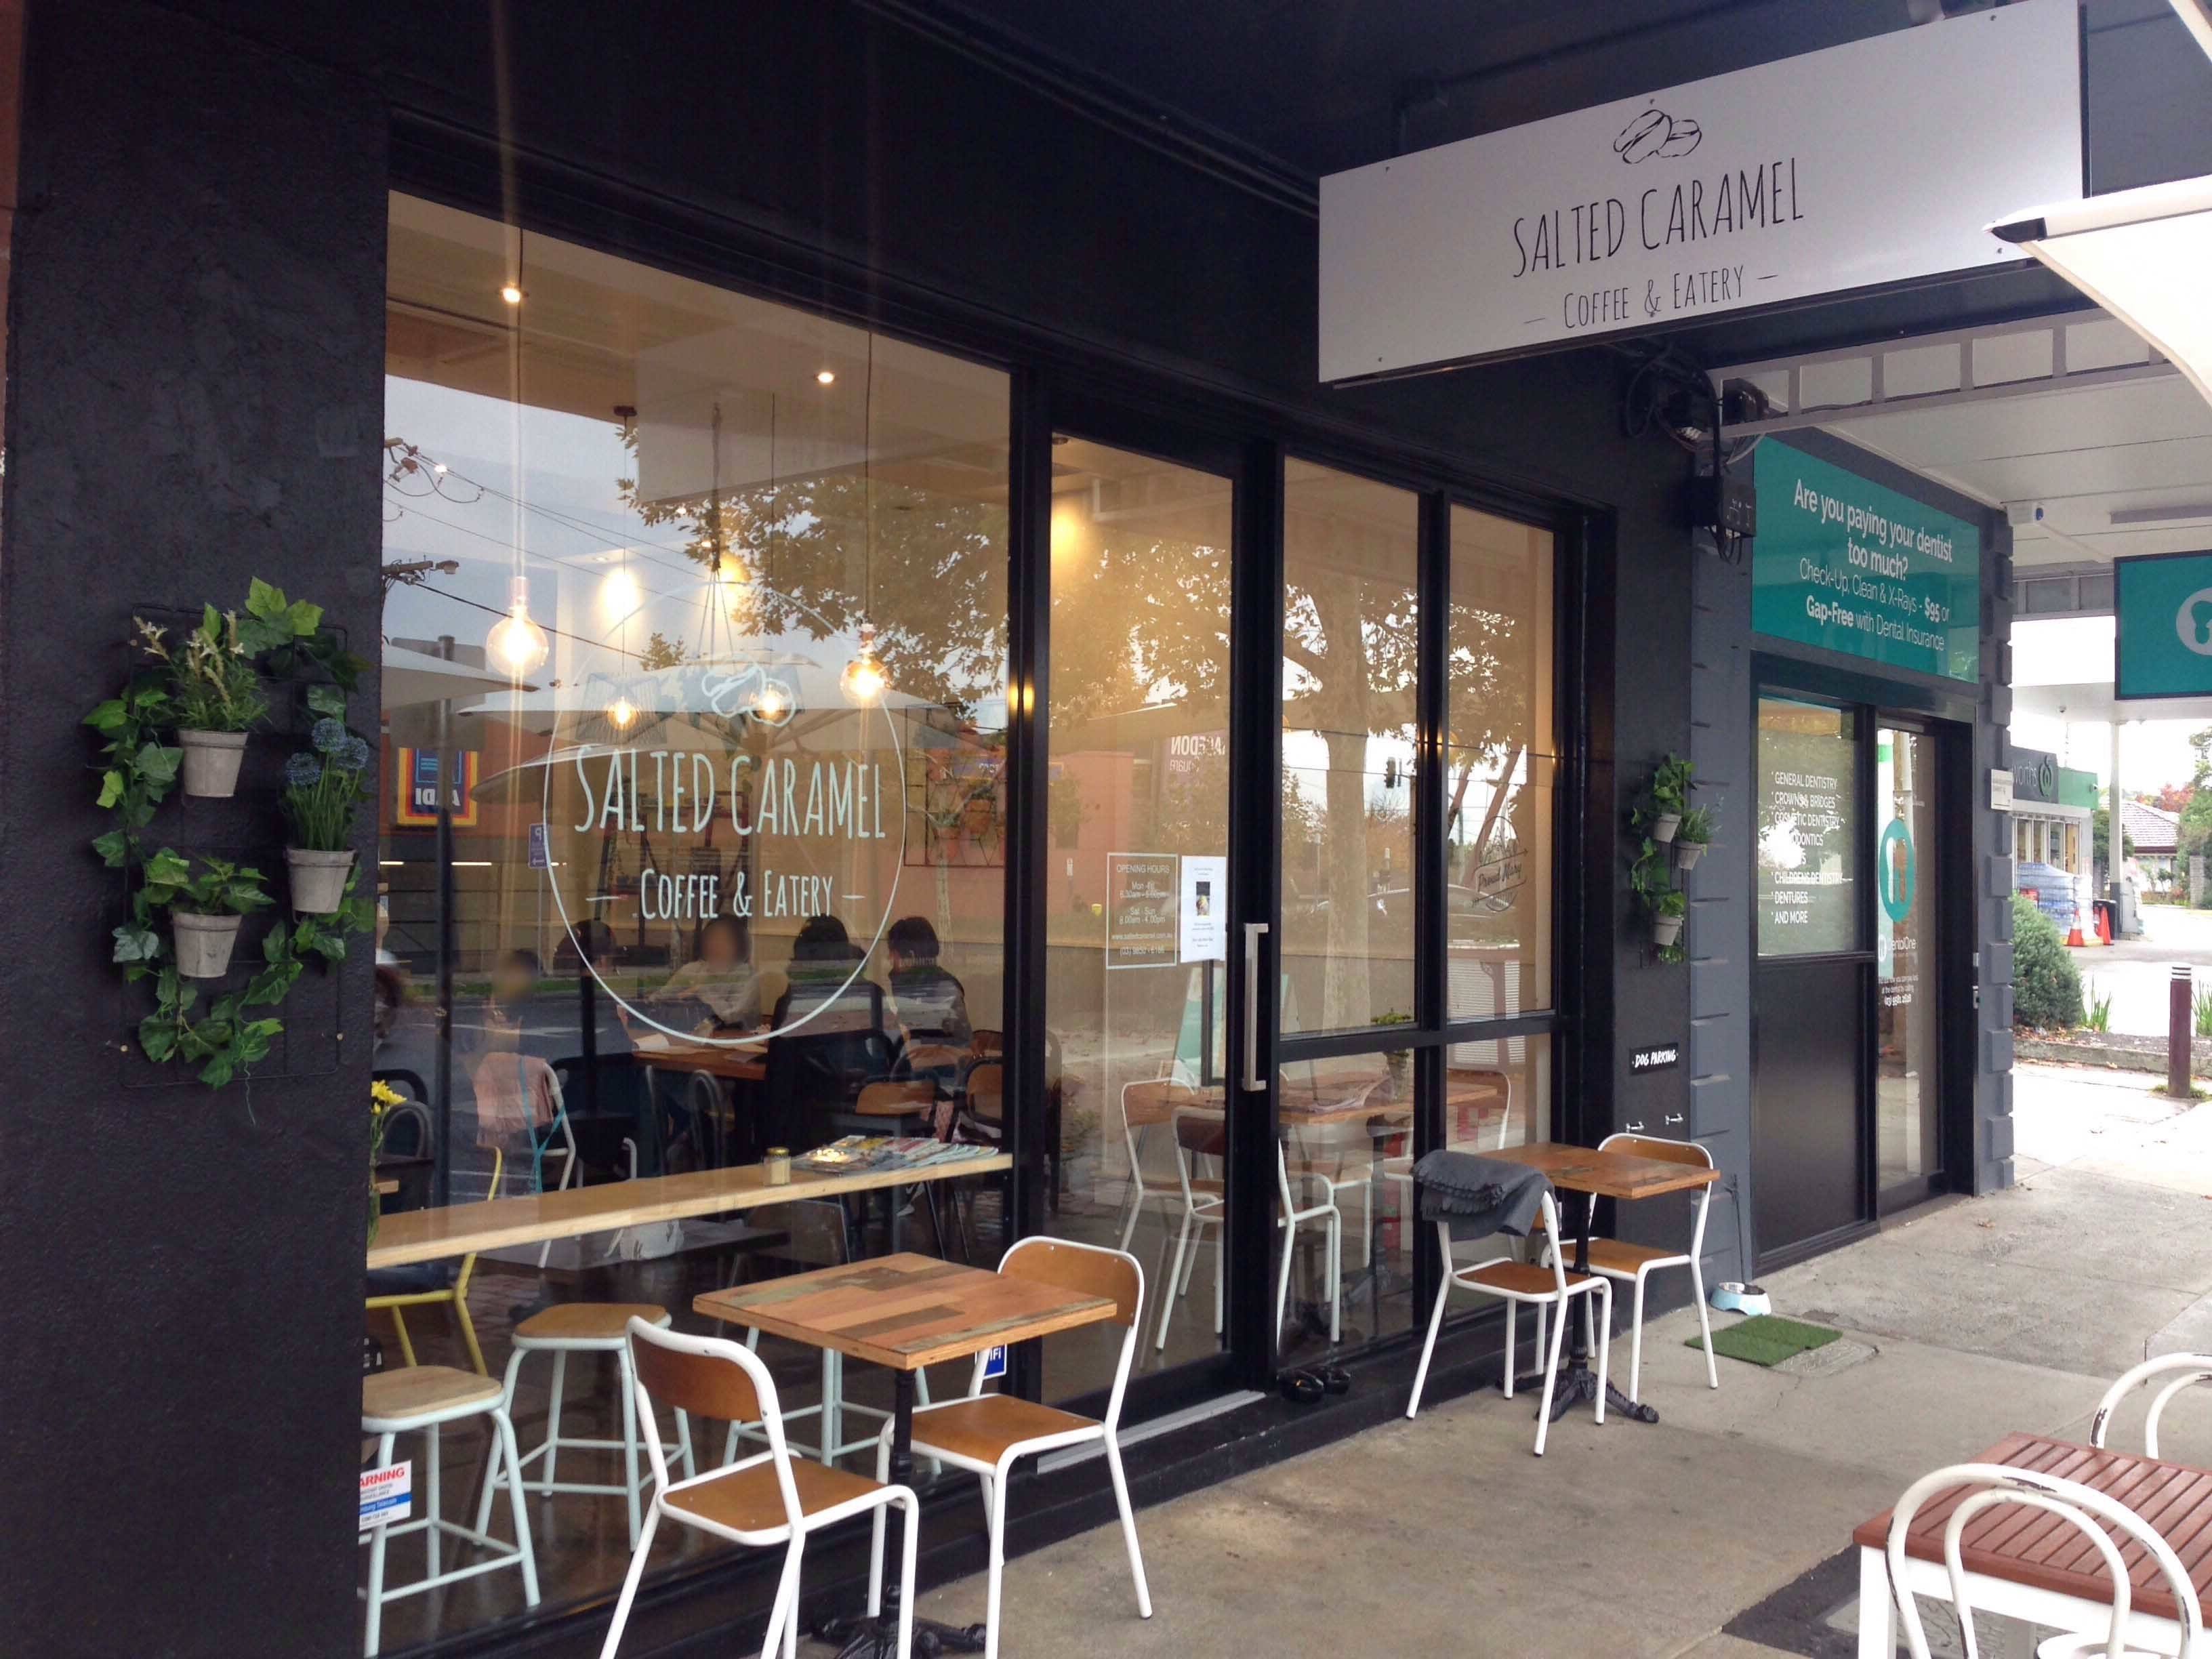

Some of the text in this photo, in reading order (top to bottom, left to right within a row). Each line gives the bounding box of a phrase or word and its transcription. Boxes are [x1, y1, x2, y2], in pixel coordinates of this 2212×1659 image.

[1513, 157, 1804, 278] SALTED CARAMEL
[1563, 265, 1745, 329] COFFEE & EATERY
[1794, 478, 1953, 563] Are you paying your dentist
[1847, 537, 1908, 581] too much?
[1852, 574, 1878, 600] Clean
[1879, 584, 1887, 601] &
[1888, 588, 1917, 617] X-Rays
[1924, 596, 1941, 623] $95
[1941, 607, 1950, 623] or
[1806, 594, 1945, 651] Gap-Free with Dental Insurance
[1775, 771, 1838, 790] GENERAL DENTISTRY
[575, 745, 886, 839] SALTED CARAMEL
[1810, 794, 1836, 808] BRIDGES
[1807, 813, 1840, 827] DENTISTRY
[1789, 832, 1824, 846] ODONTICS
[1116, 863, 1170, 874] OPENING HOURS
[640, 868, 834, 920] COFFEE & EATERY
[1775, 890, 1808, 904] DENTURES
[1775, 911, 1808, 924] AND MORE
[1634, 1050, 1676, 1068] DOG PARKING
[360, 1467, 405, 1488] ARNING
